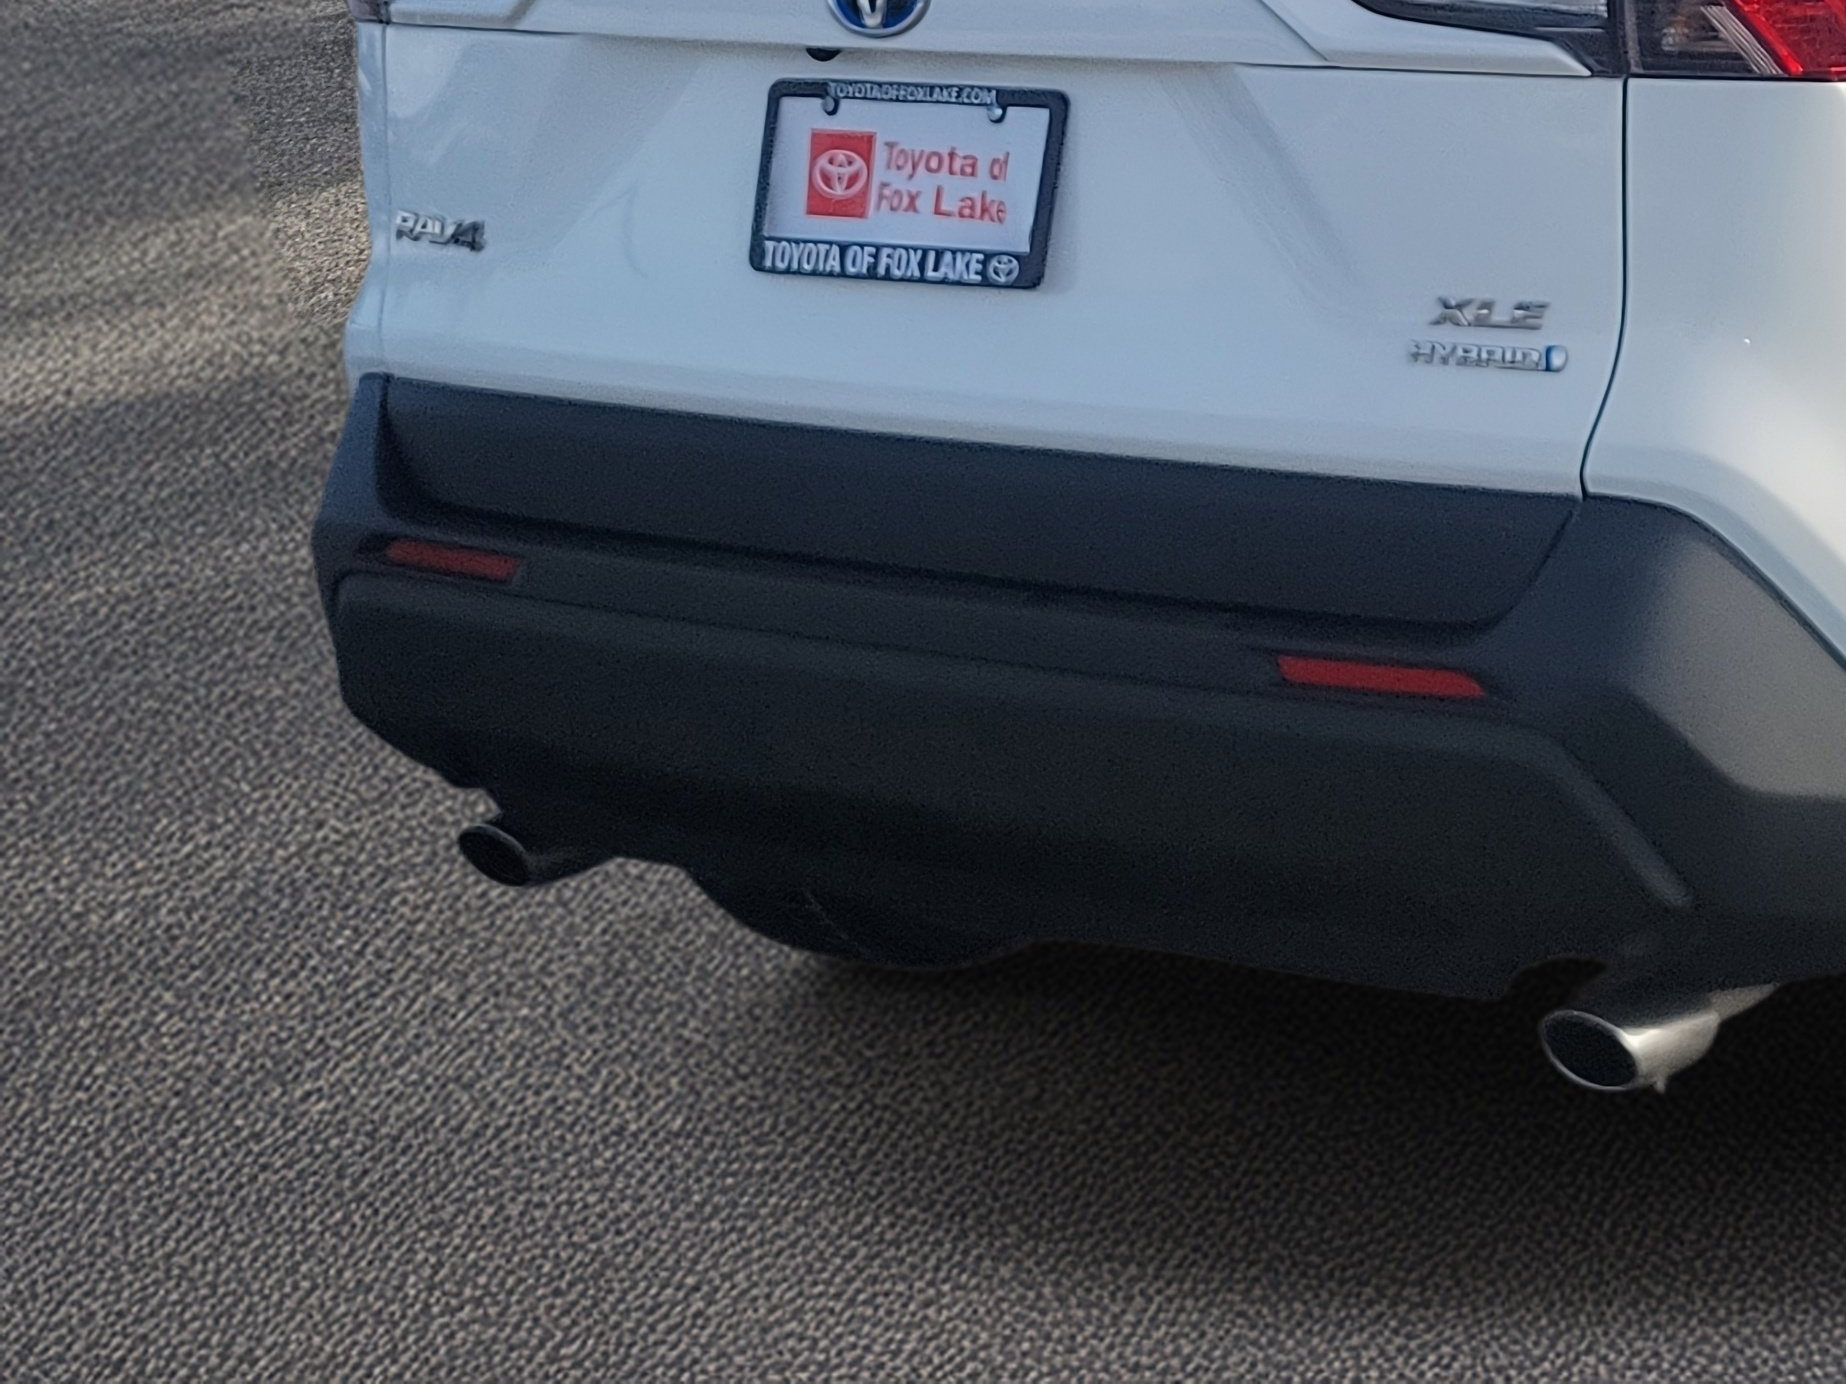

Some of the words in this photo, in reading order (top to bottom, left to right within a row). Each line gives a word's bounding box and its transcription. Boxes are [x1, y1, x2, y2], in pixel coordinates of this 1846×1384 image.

[883, 140, 979, 180] Toyota
[875, 181, 922, 215] Fox
[933, 184, 1008, 225] Lake
[395, 209, 487, 253] RAV4
[763, 239, 842, 274] TOYOTA
[845, 244, 877, 276] OF
[876, 247, 923, 280] FOX
[926, 250, 985, 283] LAKE
[1428, 296, 1551, 330] XLE
[1406, 339, 1544, 370] HYBRID
